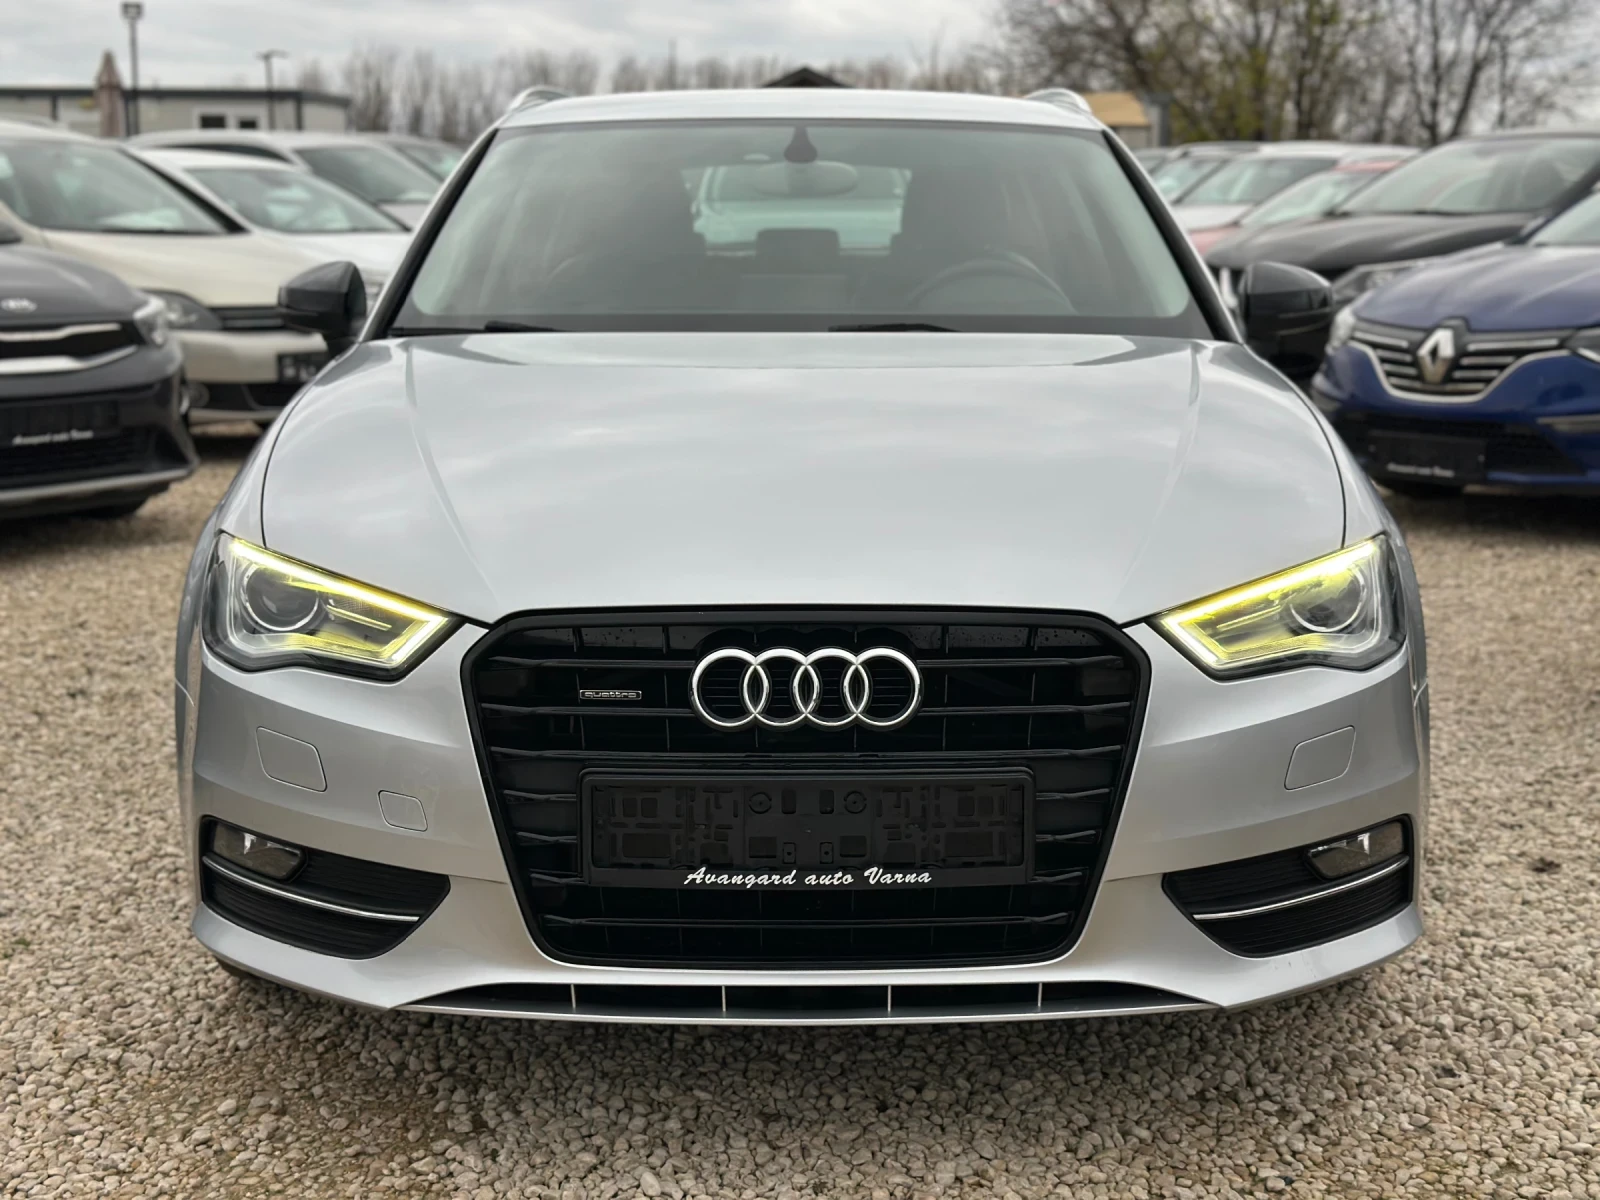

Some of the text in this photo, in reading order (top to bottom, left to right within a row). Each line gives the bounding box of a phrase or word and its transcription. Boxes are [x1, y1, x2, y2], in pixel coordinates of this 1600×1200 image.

[584, 691, 637, 699] quattro
[684, 867, 932, 888] Avangard auto Varna
